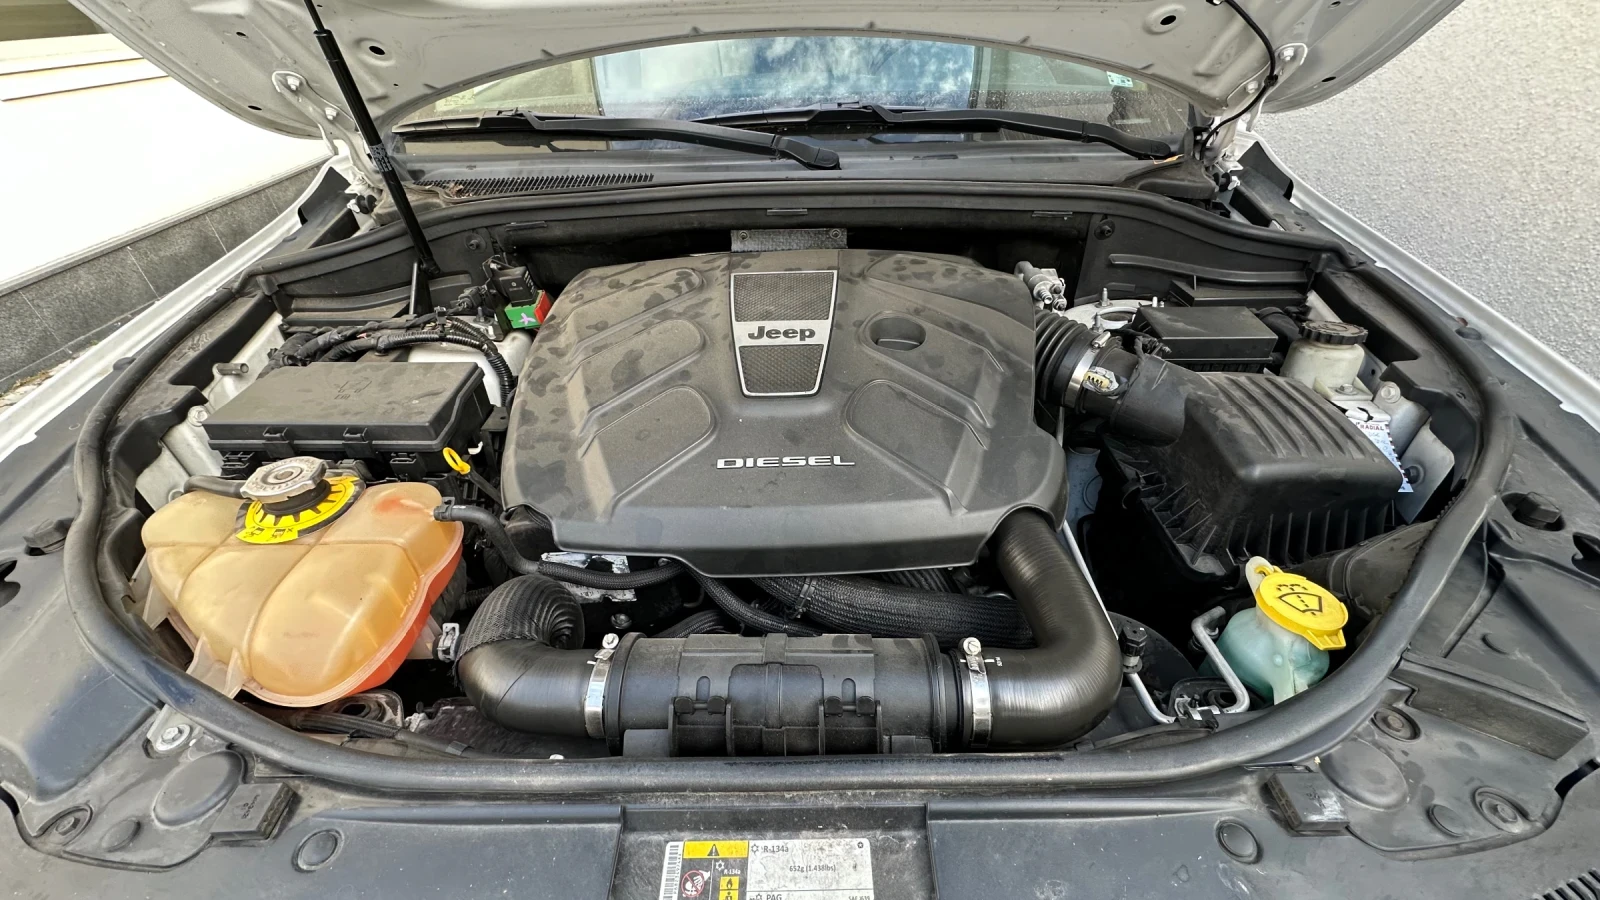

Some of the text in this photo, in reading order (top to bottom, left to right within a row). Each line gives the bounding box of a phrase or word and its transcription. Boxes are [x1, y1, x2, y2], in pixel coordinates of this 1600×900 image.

[747, 325, 816, 342] Jeep
[716, 455, 856, 470] DIESEL
[763, 845, 789, 853] R-134a
[789, 864, 836, 873] 652g (1.438lbs)
